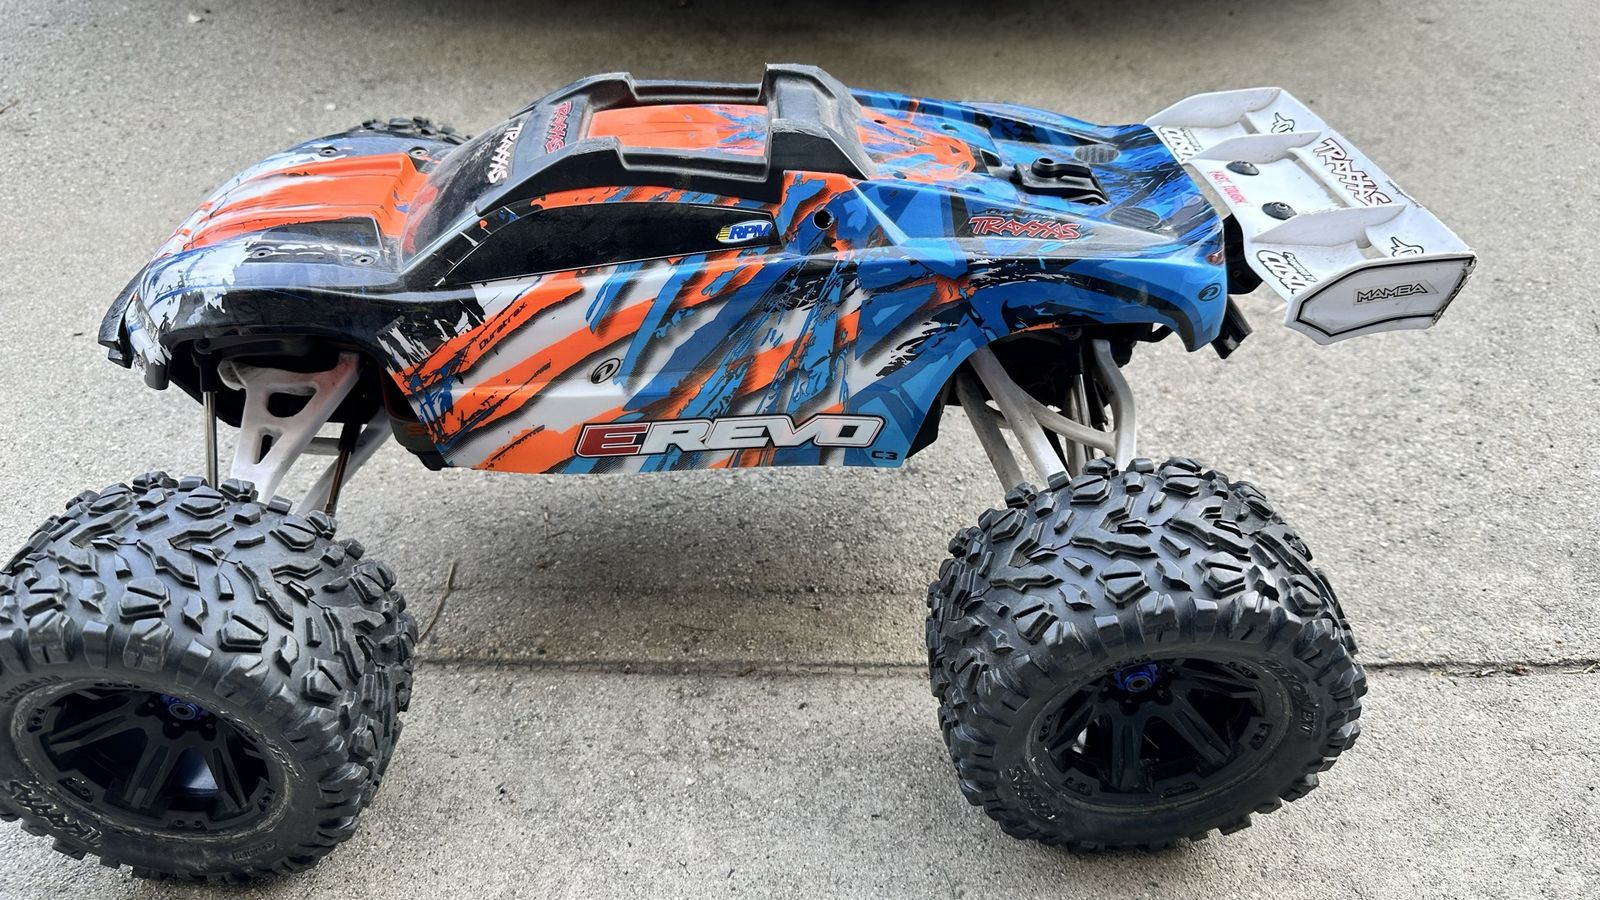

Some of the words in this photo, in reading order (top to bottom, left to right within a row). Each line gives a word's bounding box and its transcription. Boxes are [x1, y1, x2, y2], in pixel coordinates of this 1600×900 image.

[487, 122, 525, 184] TRAXXAS
[728, 222, 772, 240] RPM
[968, 216, 1081, 240] TRAXXAS
[1357, 283, 1428, 303] MAMBA
[871, 450, 898, 461] C3
